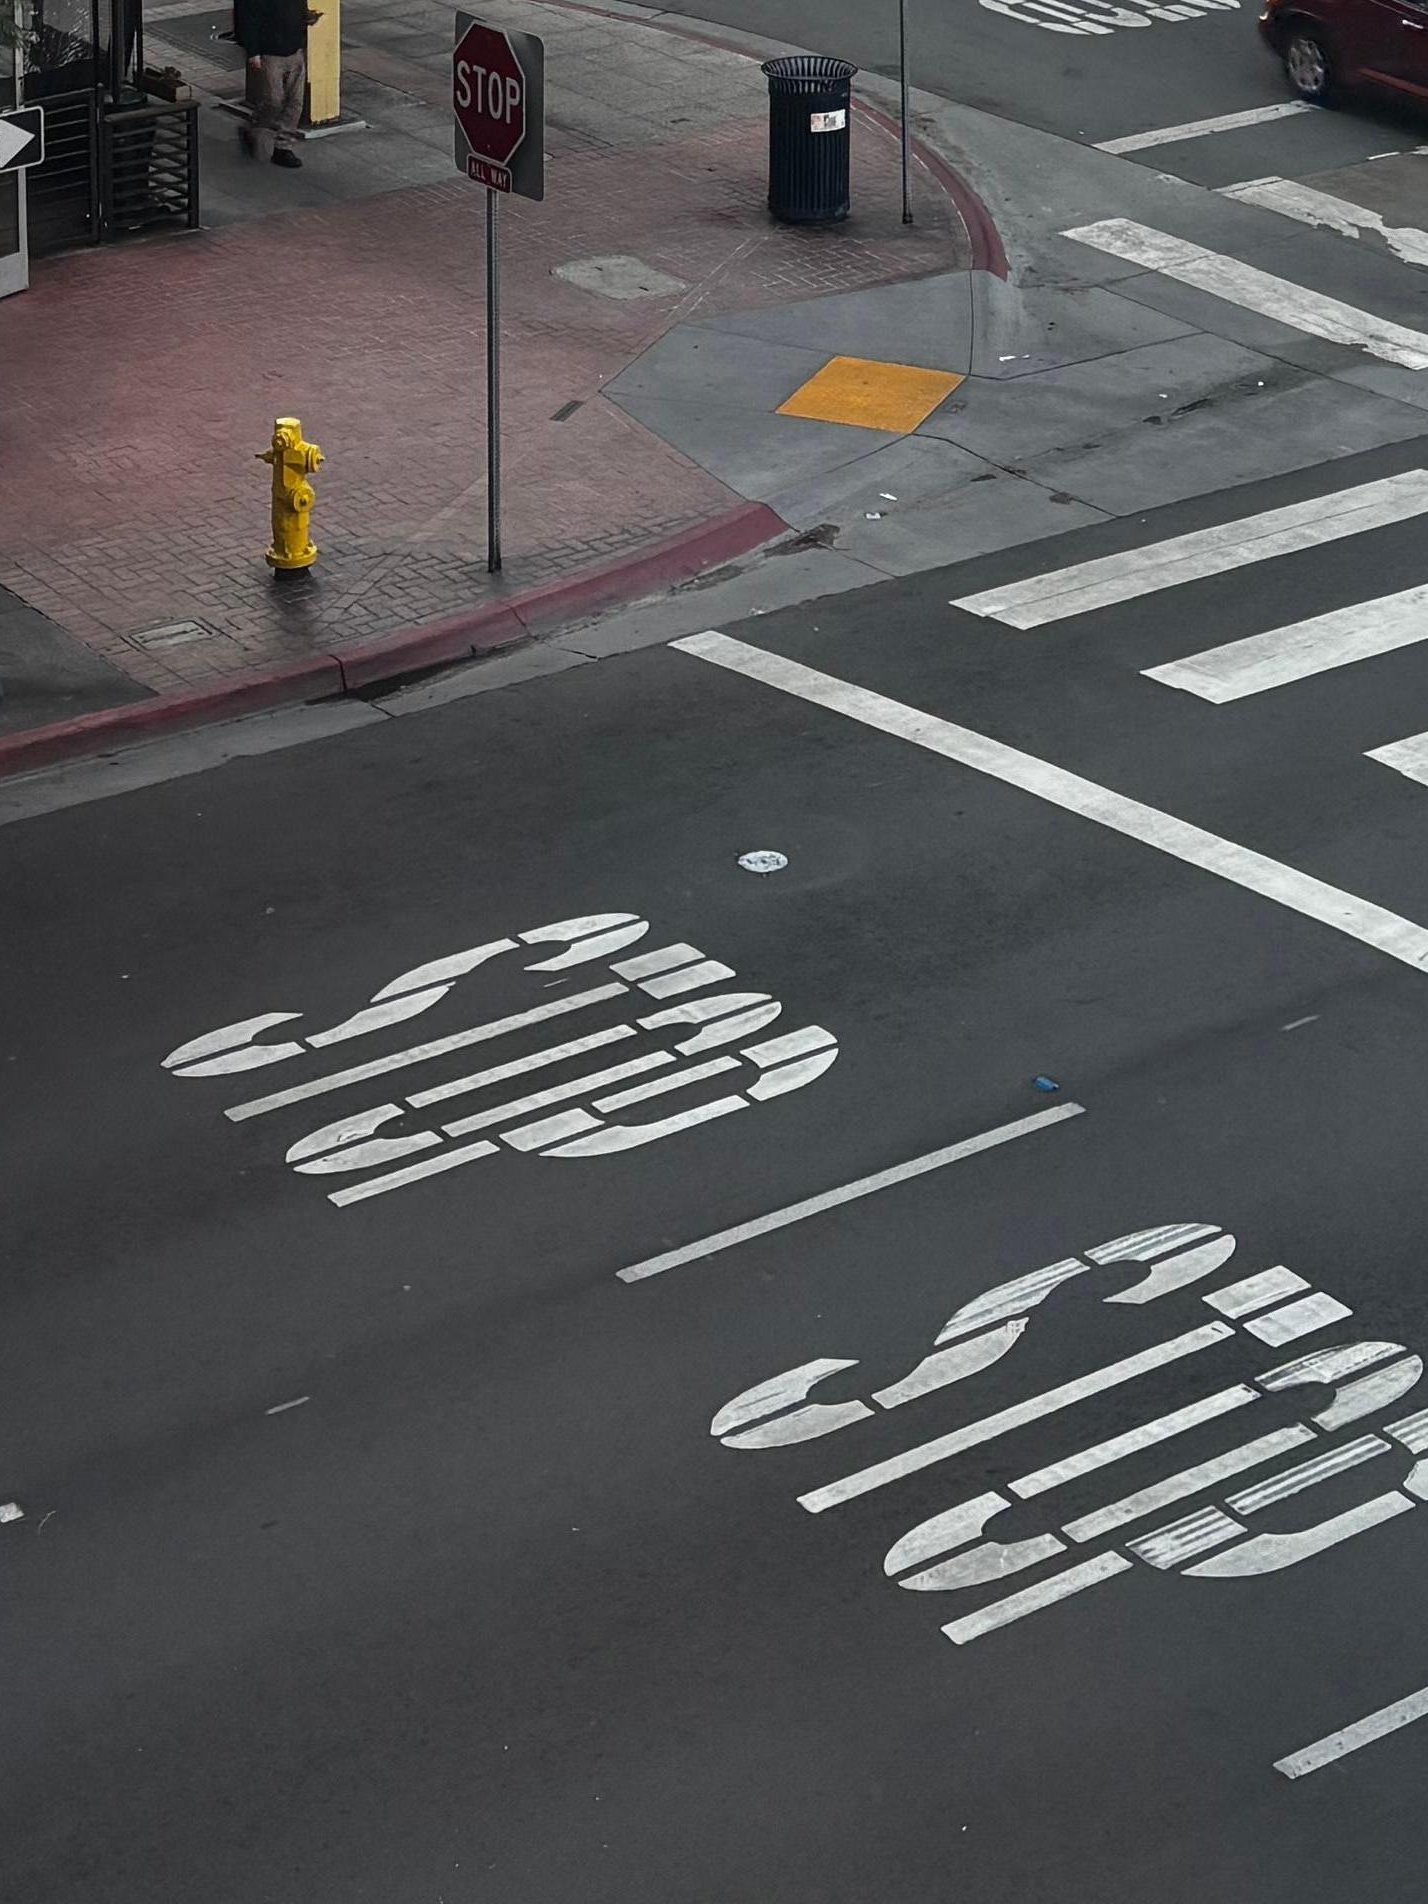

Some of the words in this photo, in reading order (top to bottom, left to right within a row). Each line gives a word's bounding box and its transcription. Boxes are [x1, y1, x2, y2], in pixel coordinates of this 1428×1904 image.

[456, 59, 520, 124] STOP
[470, 159, 486, 180] ALL
[490, 167, 507, 189] WAY
[159, 910, 840, 1208] STOP
